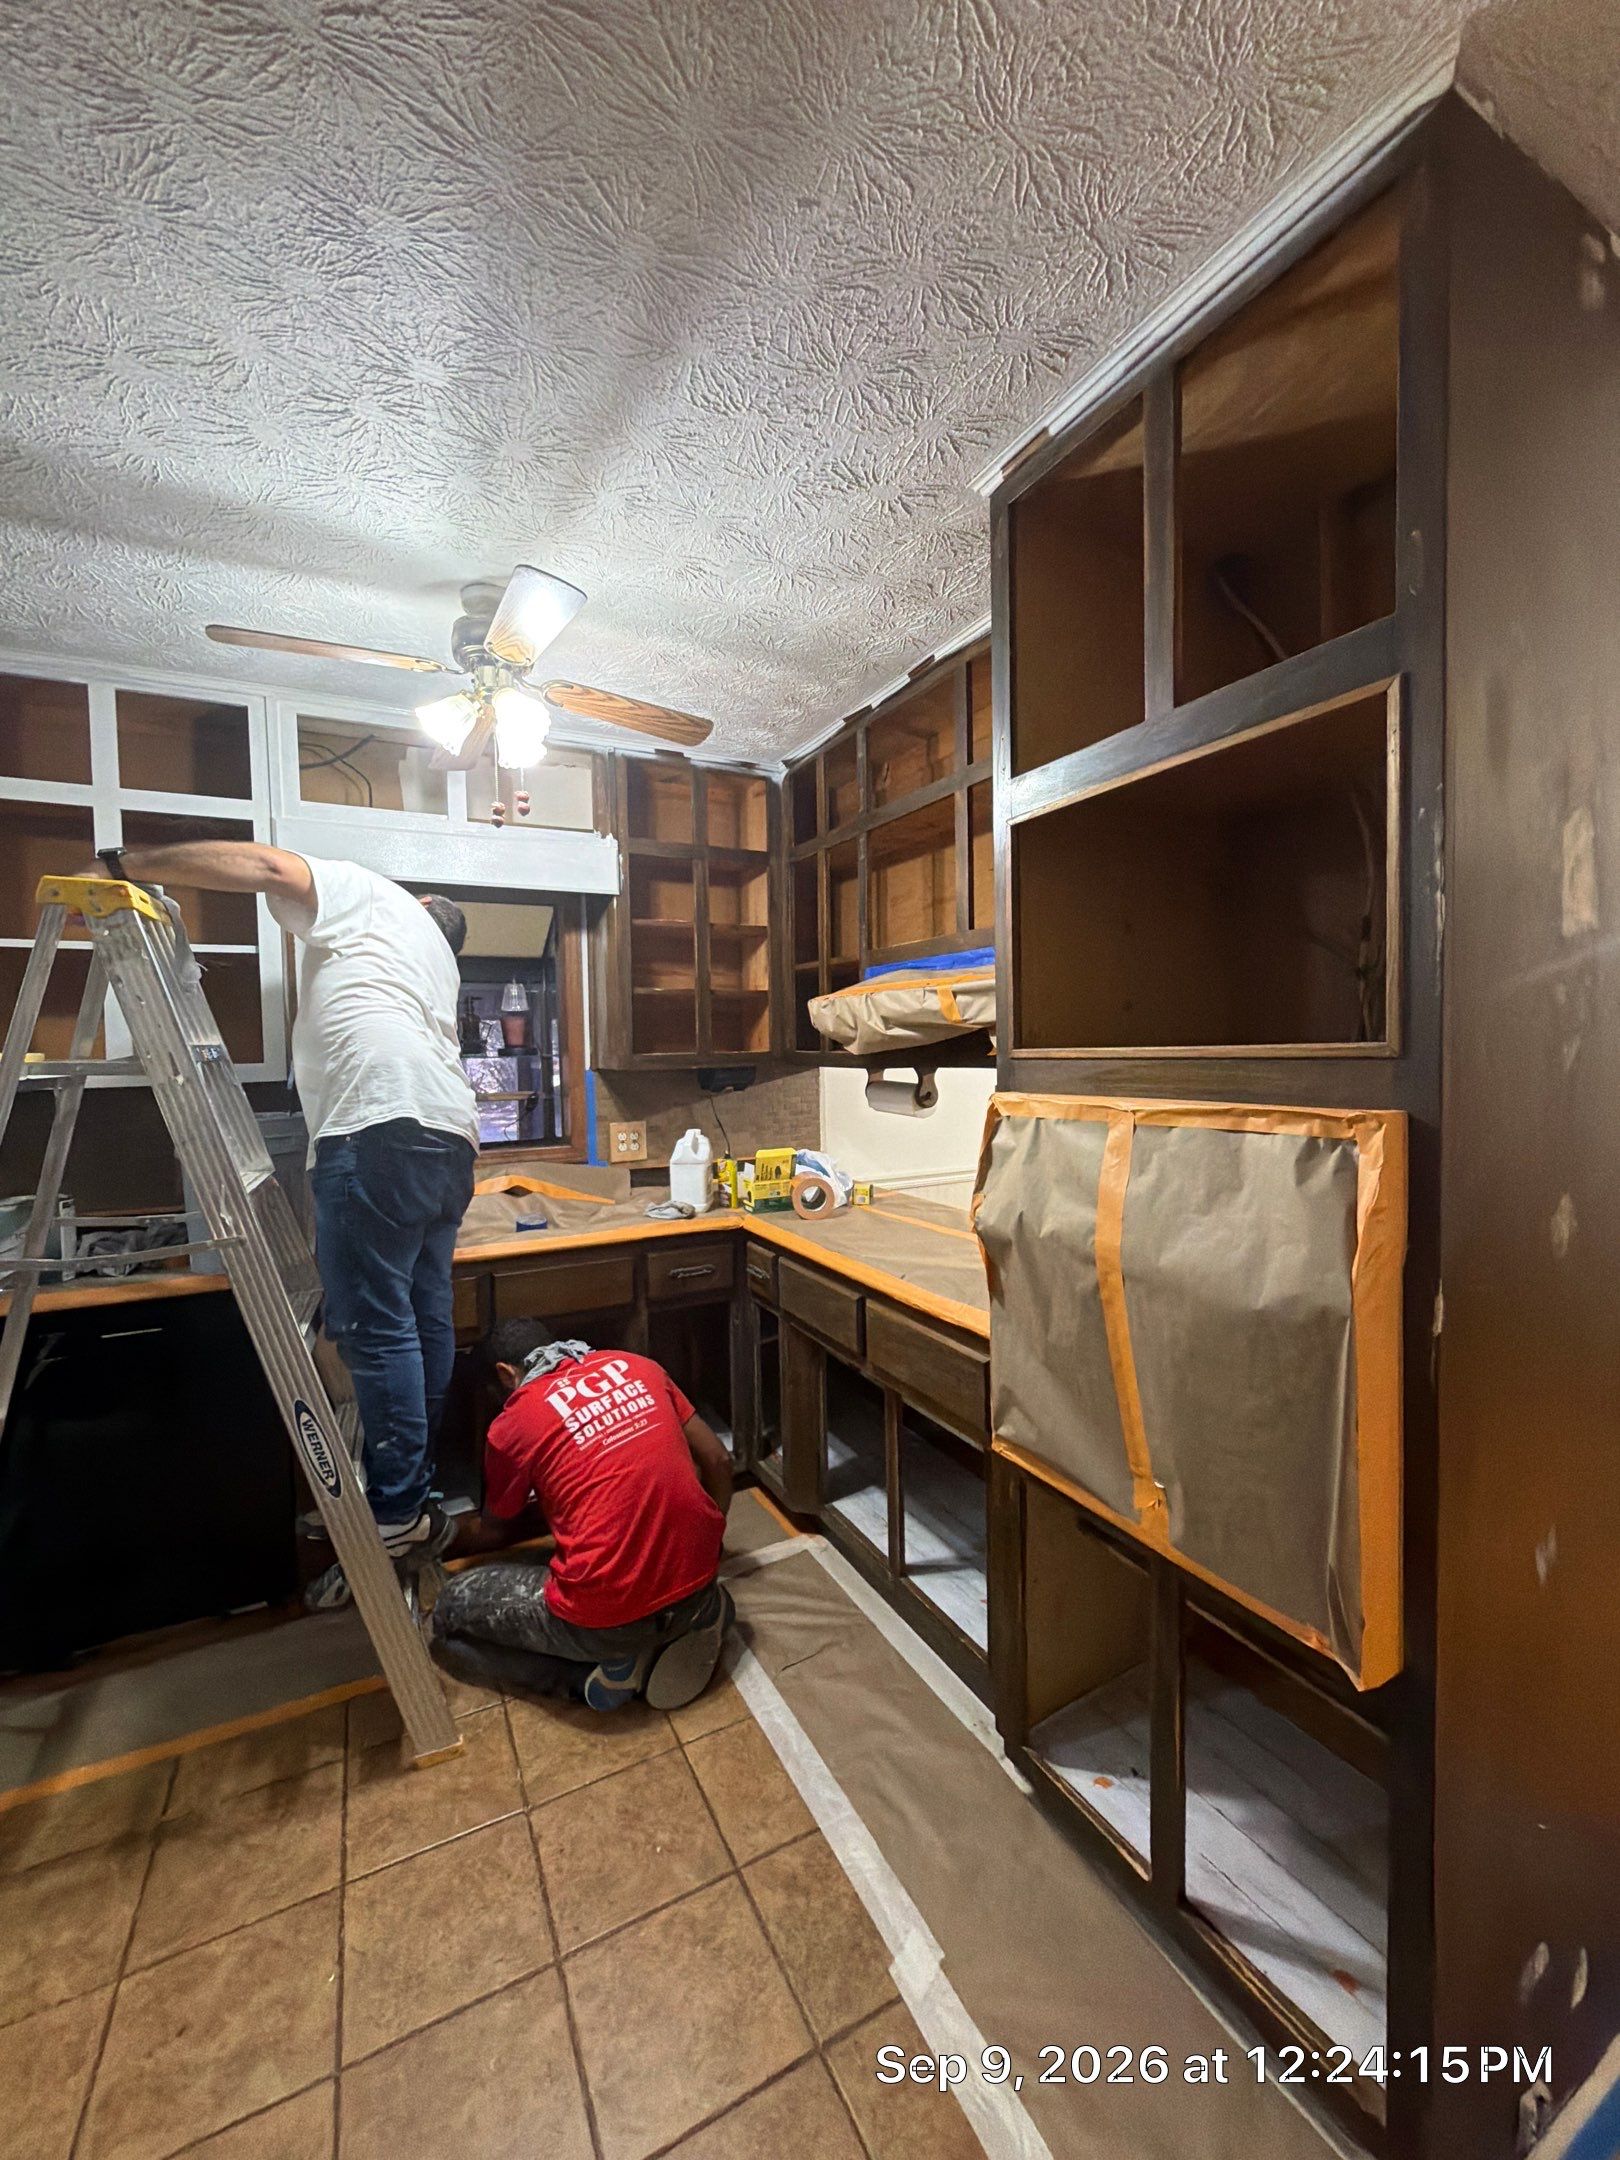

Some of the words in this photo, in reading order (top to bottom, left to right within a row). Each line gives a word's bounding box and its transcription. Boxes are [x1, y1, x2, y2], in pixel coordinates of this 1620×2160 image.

[544, 1359, 631, 1422] PGP
[565, 1379, 648, 1433] SURFACE
[573, 1394, 655, 1444] SOLUTIONS
[302, 1418, 335, 1480] WERNER
